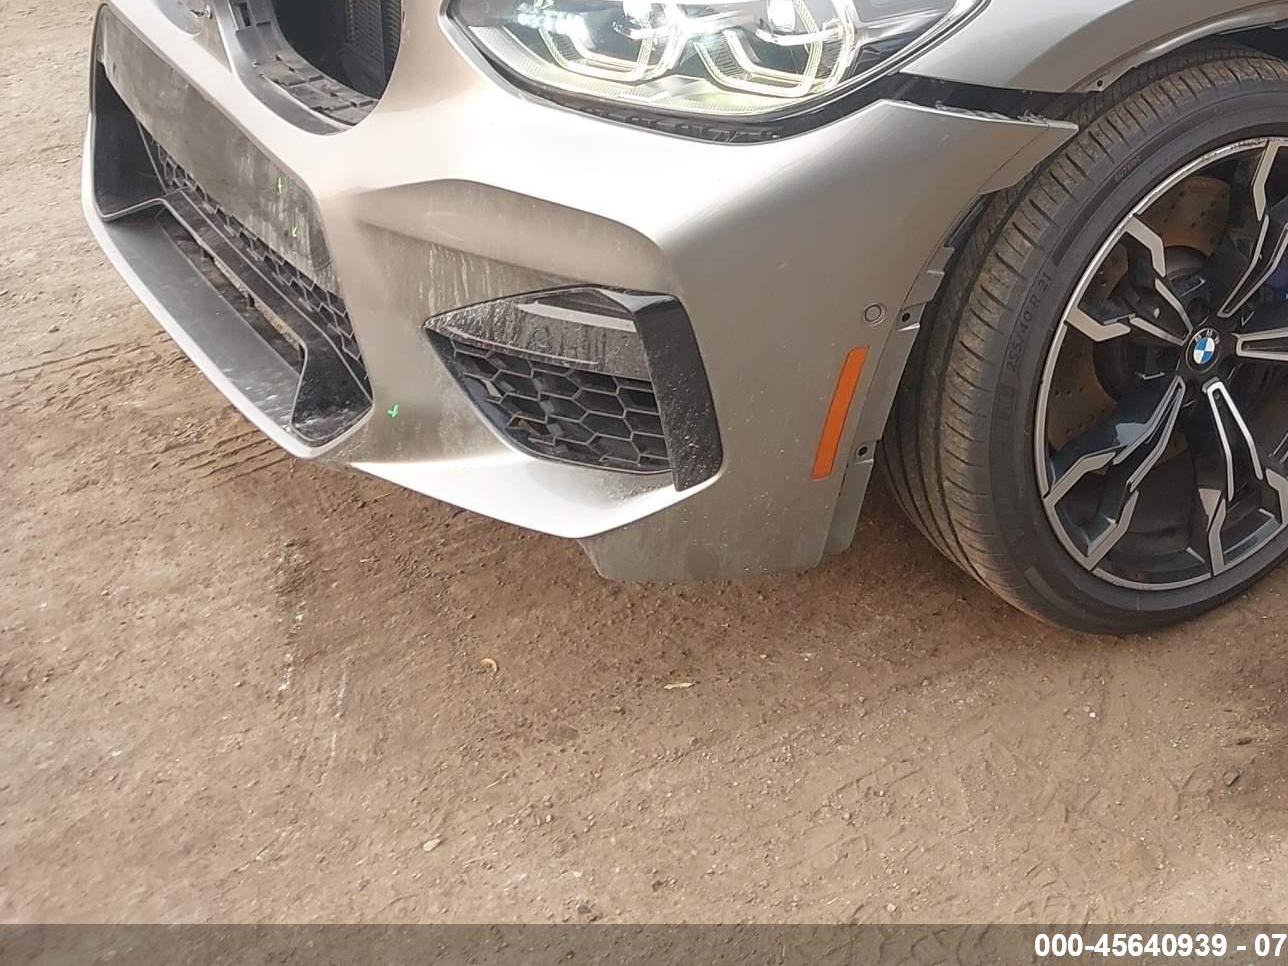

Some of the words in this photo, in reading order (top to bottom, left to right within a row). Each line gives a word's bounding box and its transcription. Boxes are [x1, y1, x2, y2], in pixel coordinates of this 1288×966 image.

[1006, 310, 1034, 373] 255/40
[1029, 295, 1041, 308] R
[1038, 271, 1052, 291] 21
